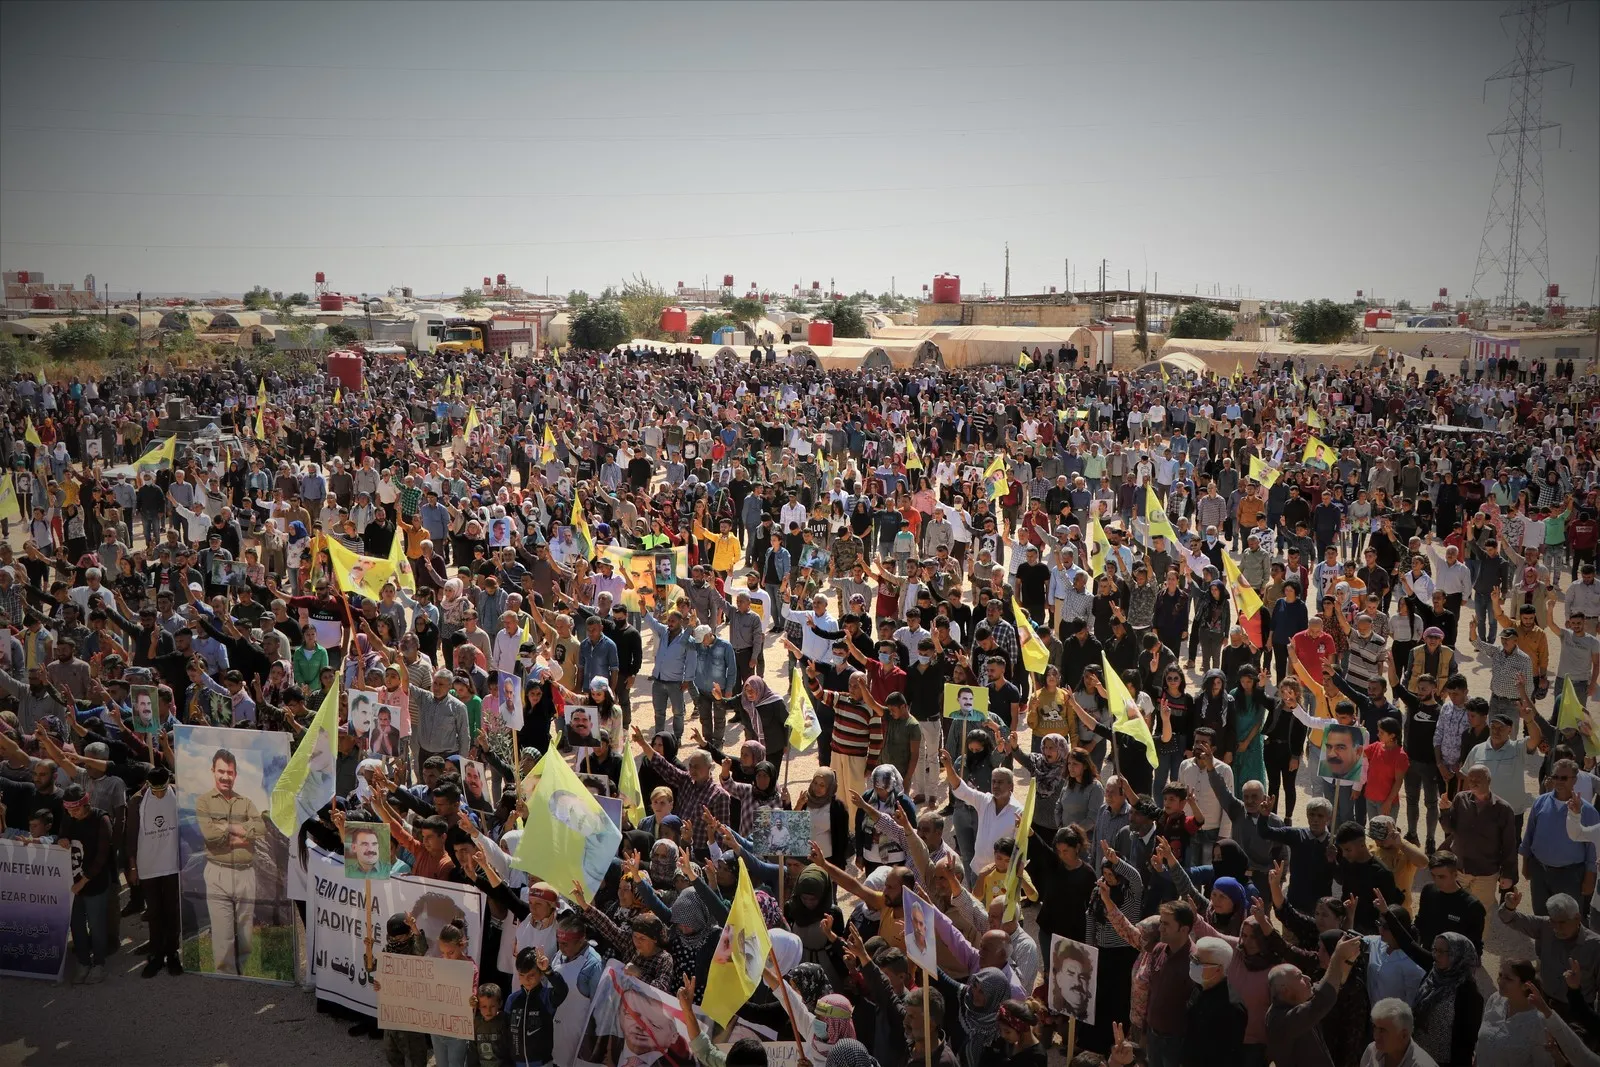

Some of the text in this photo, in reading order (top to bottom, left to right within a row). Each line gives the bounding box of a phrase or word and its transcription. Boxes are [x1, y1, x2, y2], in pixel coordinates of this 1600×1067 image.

[1040, 720, 1068, 729] MINNIE
[47, 866, 61, 877] YA
[29, 893, 58, 905] DIKIN
[338, 885, 380, 914] DEMA
[331, 957, 355, 982] وقت
[382, 955, 434, 980] BIMRE
[382, 977, 463, 1006] KOMPLOYA
